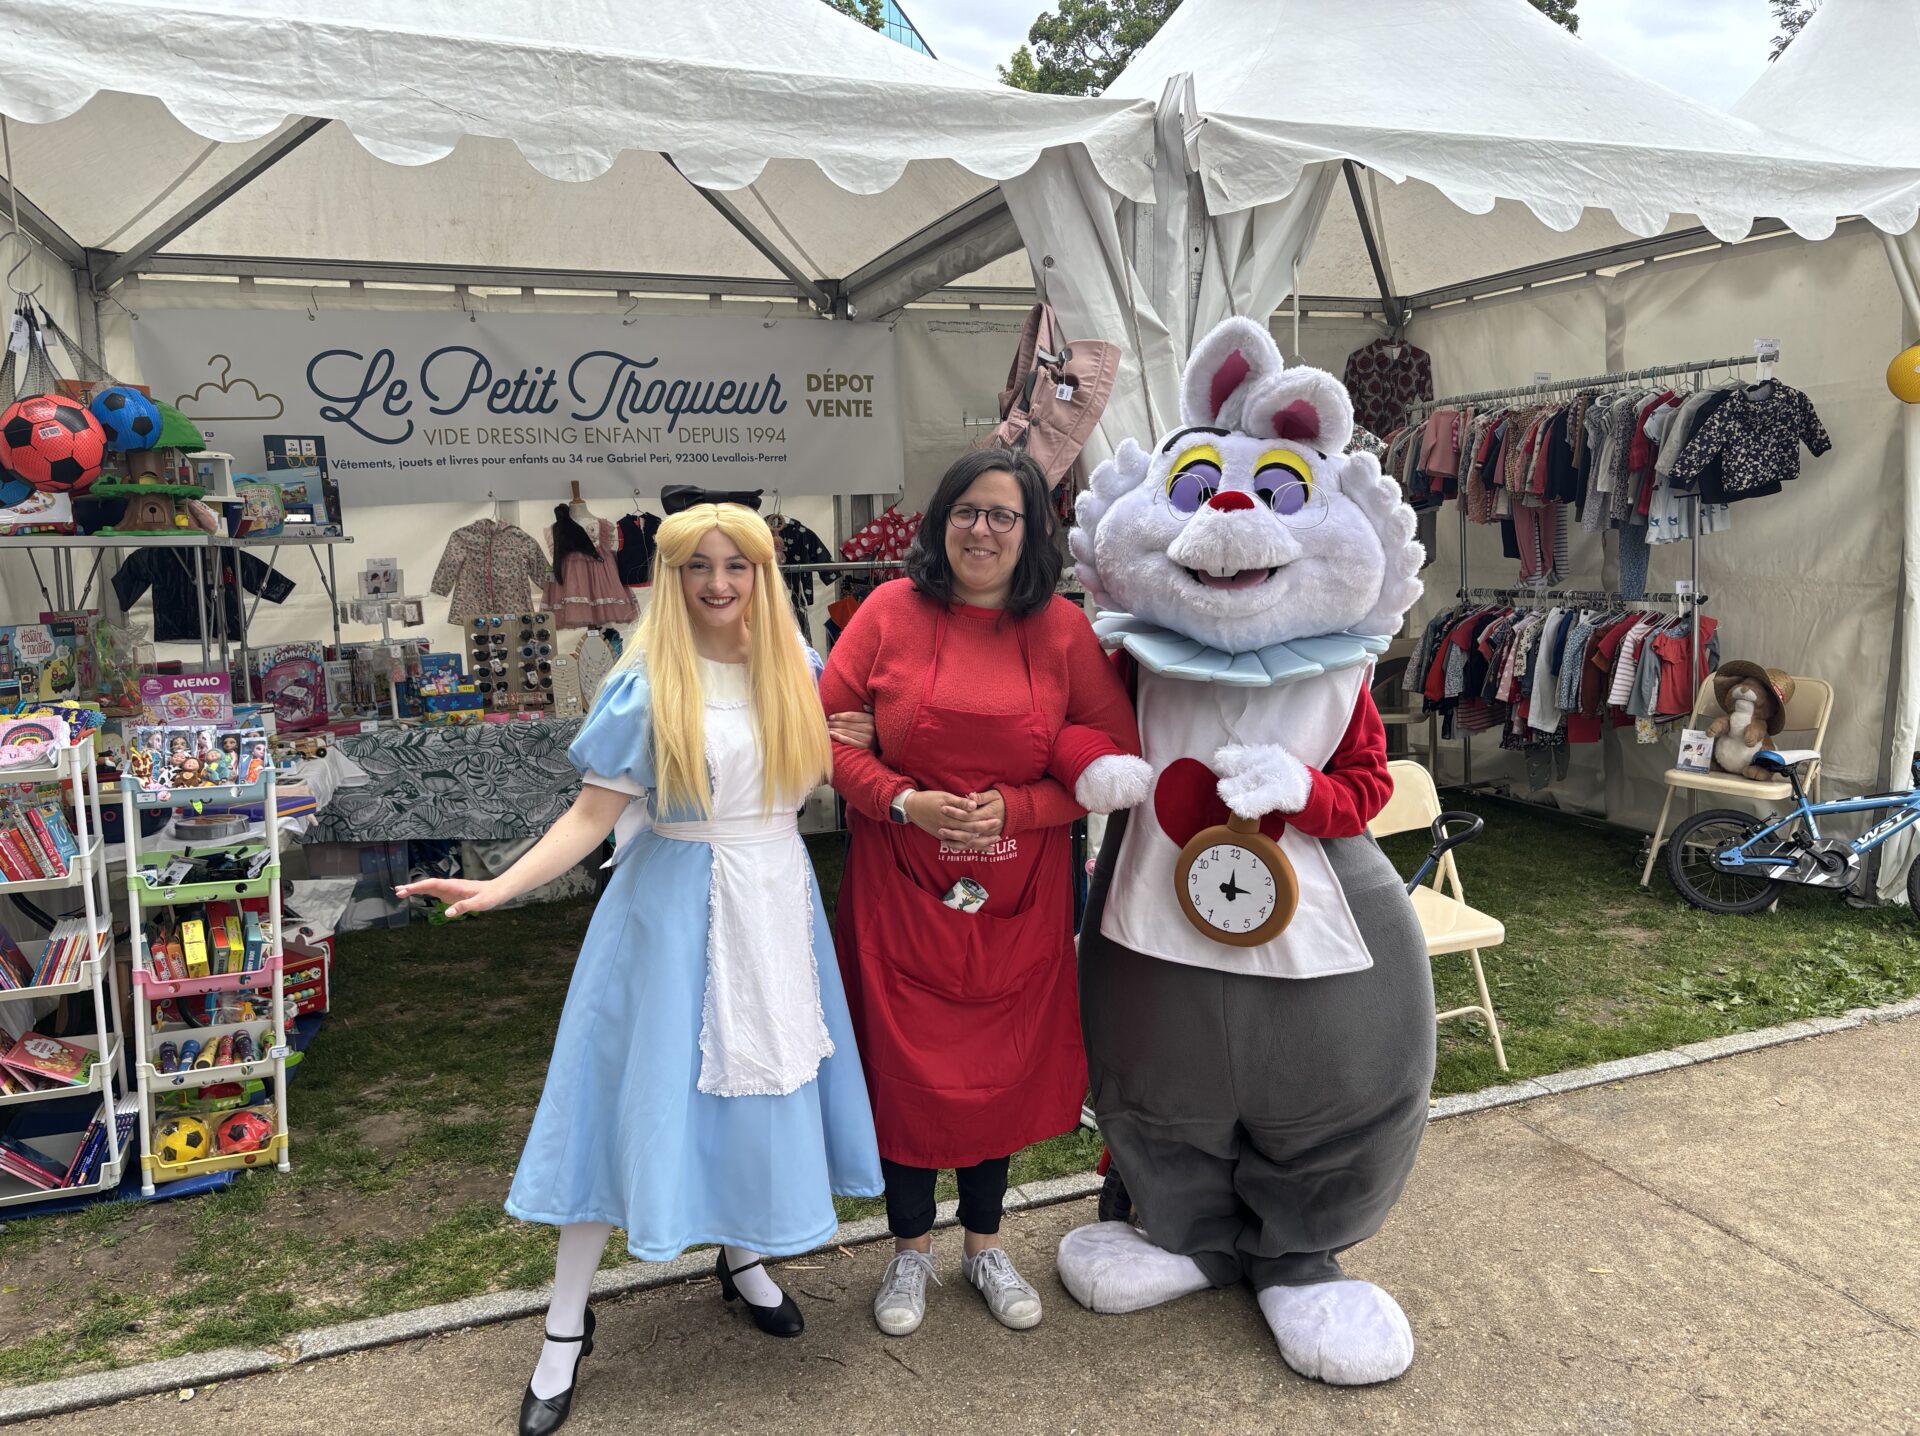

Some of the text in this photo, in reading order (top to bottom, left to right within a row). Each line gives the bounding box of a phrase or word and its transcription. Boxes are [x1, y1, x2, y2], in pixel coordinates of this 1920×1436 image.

[806, 368, 874, 393] DÉPOT
[306, 345, 788, 445] Le Petit Troqueur
[805, 399, 873, 418] VENTE
[424, 427, 787, 446] VIDE DRESSING ENFANT DEPUIS 1994
[331, 452, 787, 470] Vêtements, jouets et livres pour enfants au 34 rue Gabriel Peri, 92300 Levallois-Perret
[275, 649, 311, 663] GEMMIES
[173, 676, 220, 688] MEMO
[1856, 810, 1907, 844] WST
[989, 851, 1018, 863] LEVALLOIS
[1210, 849, 1220, 861] 11
[1230, 848, 1241, 860] 12
[1198, 858, 1209, 870] 10
[1252, 858, 1257, 868] 1
[1191, 873, 1198, 884] 9
[1264, 876, 1272, 887] 2
[1194, 894, 1201, 906] 8
[1267, 894, 1274, 904] 3
[1258, 906, 1266, 919] 4
[1222, 919, 1230, 929] 6
[1243, 918, 1251, 929] 5
